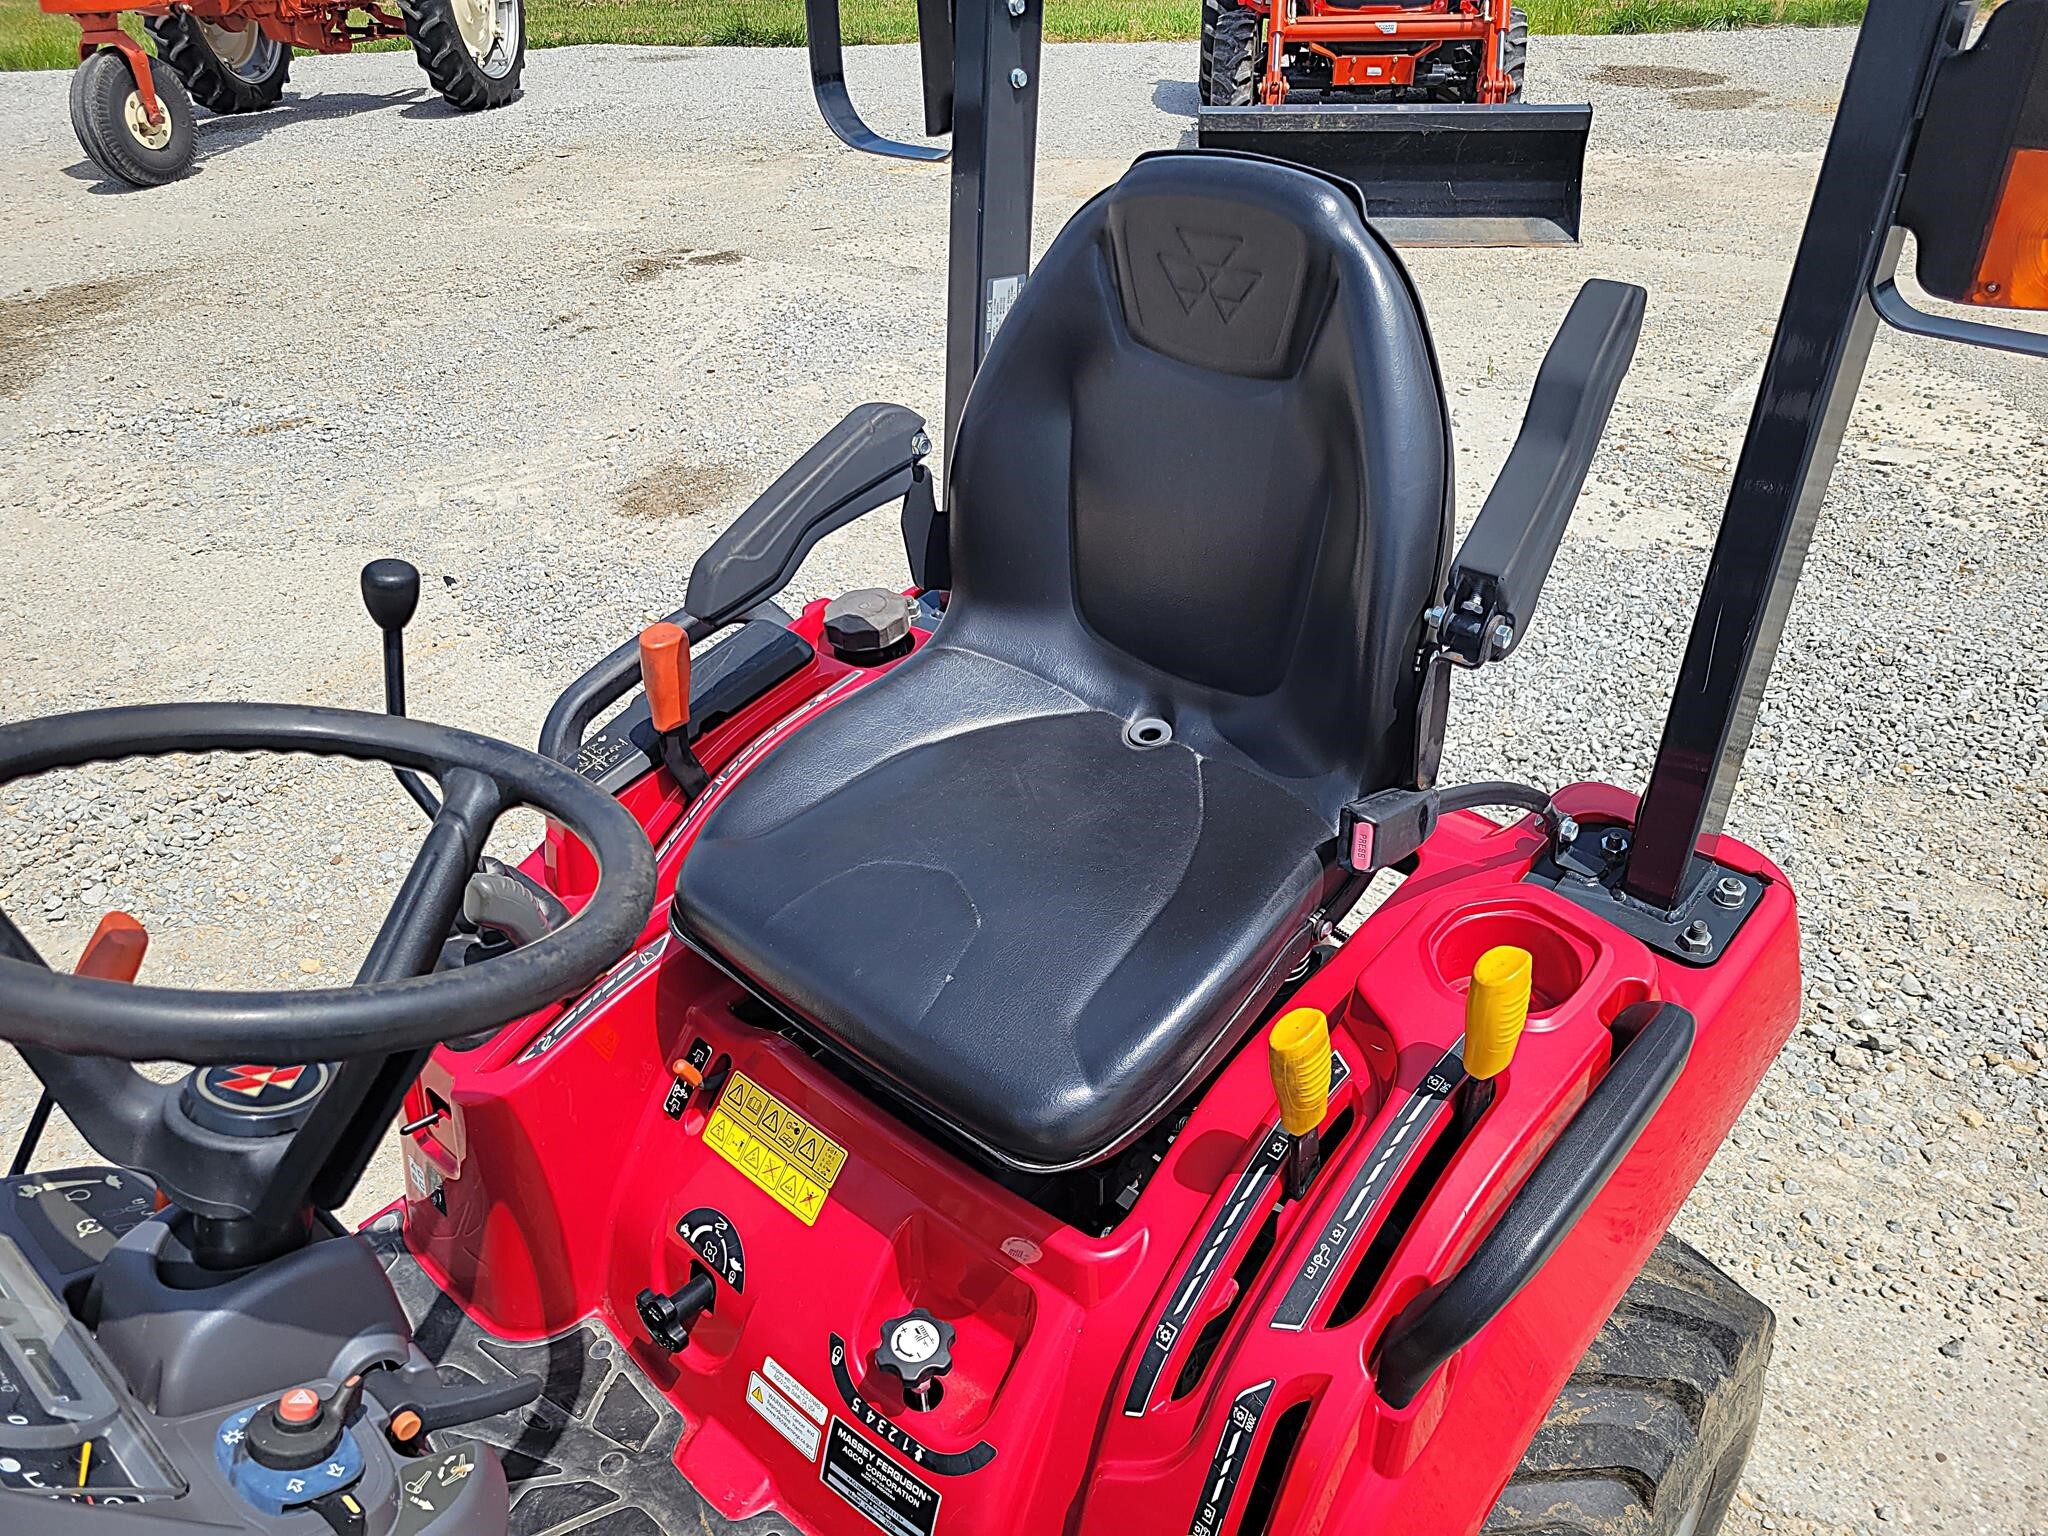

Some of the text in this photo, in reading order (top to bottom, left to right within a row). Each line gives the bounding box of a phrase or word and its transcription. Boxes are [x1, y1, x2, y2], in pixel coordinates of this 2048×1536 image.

[1357, 833, 1367, 858] PRESS
[851, 1397, 861, 1413] 5
[865, 1410, 876, 1424] 4
[1245, 1413, 1257, 1433] 2000
[876, 1419, 887, 1434] 3
[888, 1426, 898, 1442] 2
[837, 1427, 876, 1462] MASSEY
[842, 1445, 863, 1465] AGCO
[866, 1463, 920, 1508] CORPORATION
